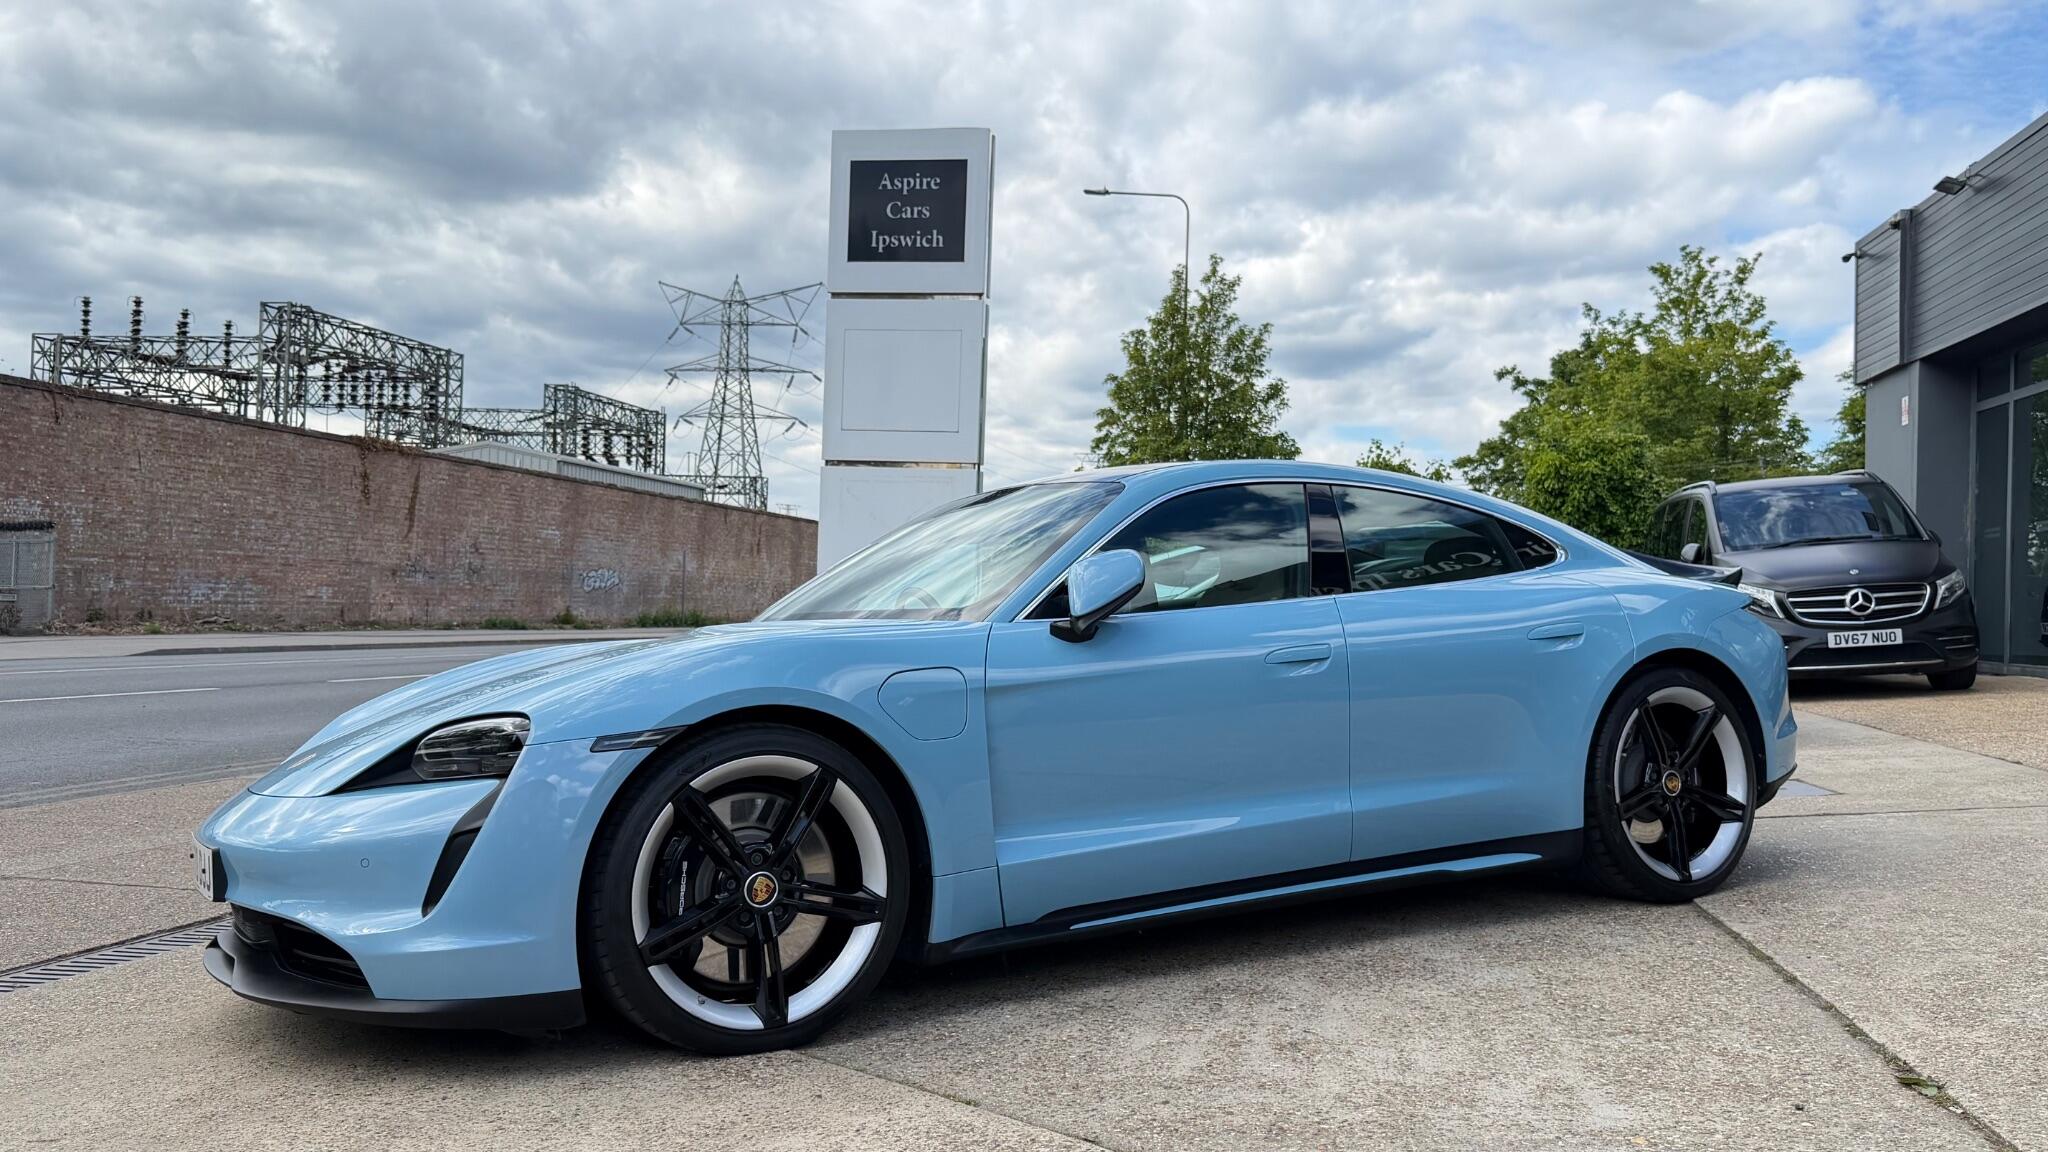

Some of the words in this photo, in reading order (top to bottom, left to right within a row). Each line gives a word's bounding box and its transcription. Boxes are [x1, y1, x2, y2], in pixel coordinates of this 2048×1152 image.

[878, 173, 940, 195] Aspire
[886, 201, 930, 219] Cars
[871, 229, 944, 253] Ipswich
[1834, 633, 1868, 646] DV67
[1872, 631, 1897, 644] NUO
[678, 860, 688, 916] PORSCHE
